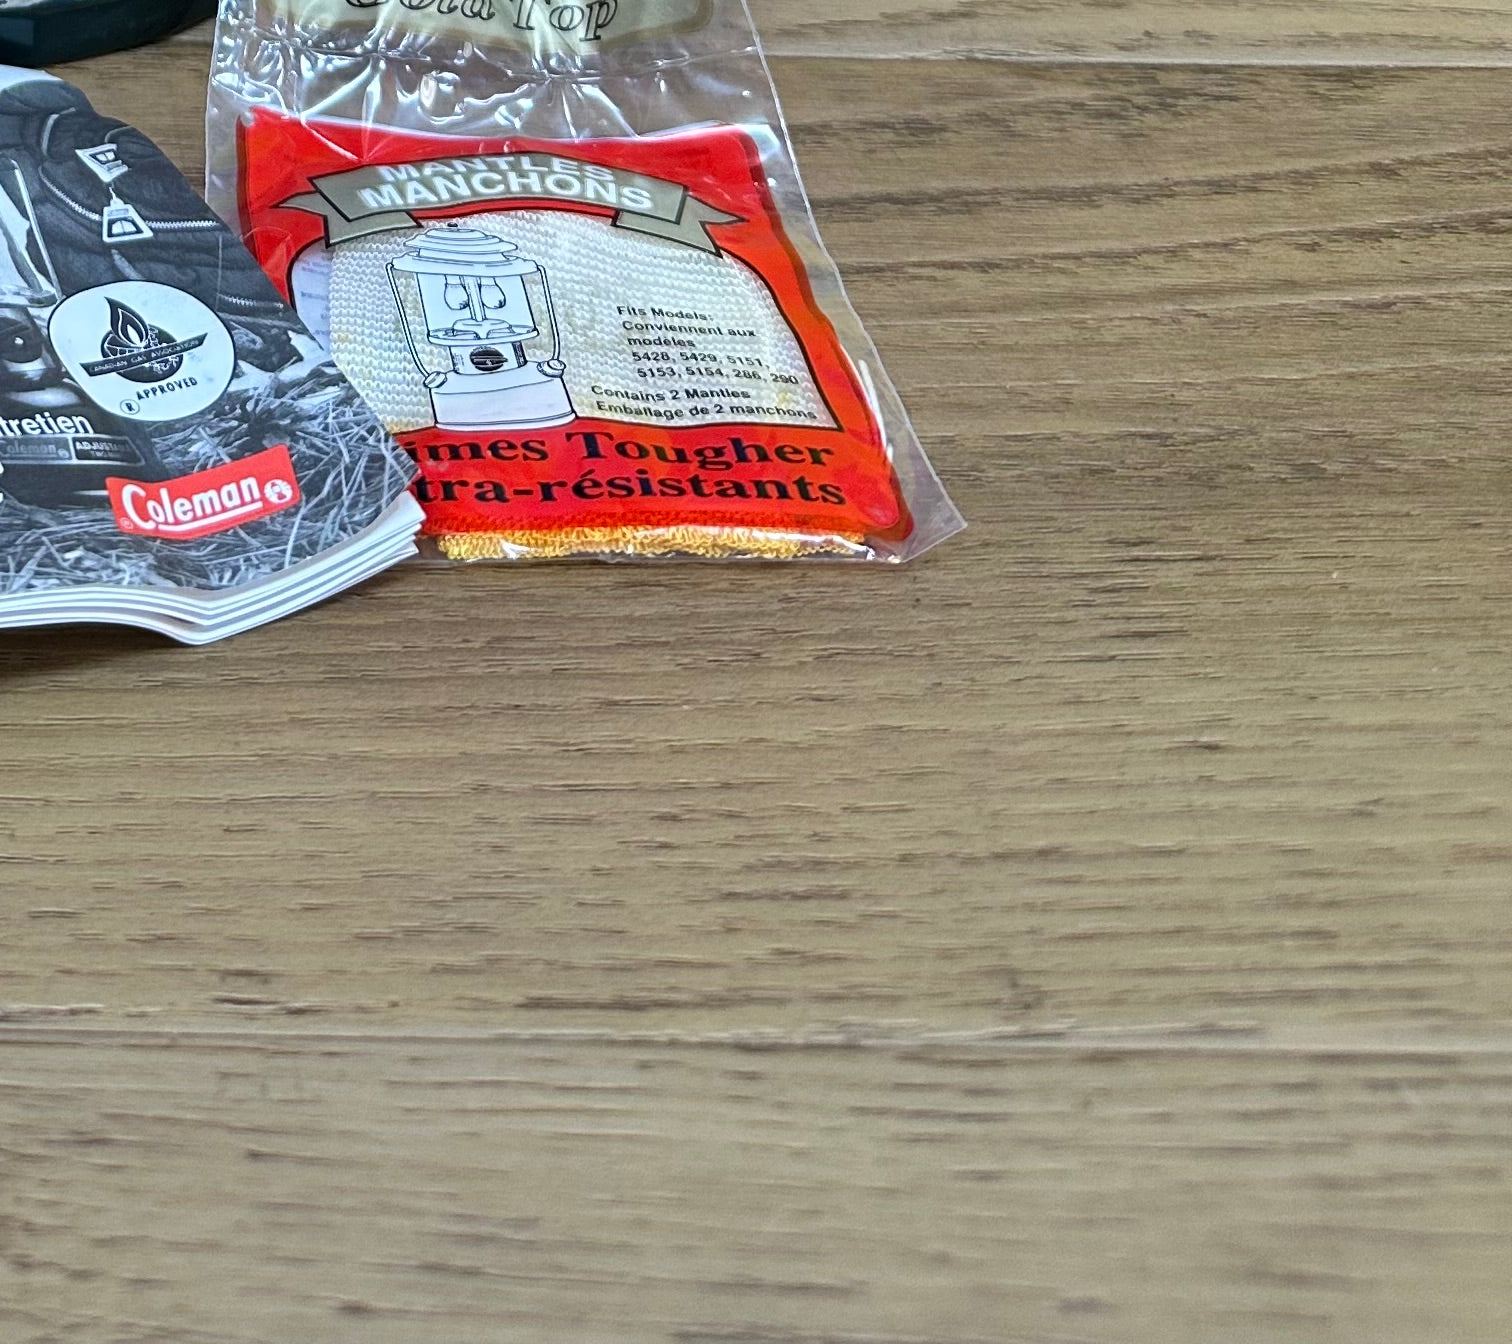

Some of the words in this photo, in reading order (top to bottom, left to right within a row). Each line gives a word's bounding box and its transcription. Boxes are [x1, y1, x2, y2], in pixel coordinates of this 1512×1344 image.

[375, 156, 616, 183] MANTLES
[357, 171, 654, 210] MANCHONS
[616, 305, 647, 316] Fits
[650, 307, 714, 321] Models:
[622, 321, 723, 336] Conviennent
[728, 327, 756, 338] aux
[632, 351, 676, 363] 5428,
[727, 355, 770, 369] 5151,
[637, 367, 682, 379] 5153,
[686, 366, 730, 379] 5154,
[136, 376, 198, 401] APPROVED
[591, 385, 665, 402] Contains
[669, 389, 681, 400] 2
[685, 388, 751, 400] Mantles
[596, 401, 684, 420] Emballage
[689, 405, 710, 417] de
[713, 404, 724, 415] 2
[730, 405, 818, 420] manchons
[565, 431, 834, 471] Tougher
[121, 476, 261, 530] Coleman
